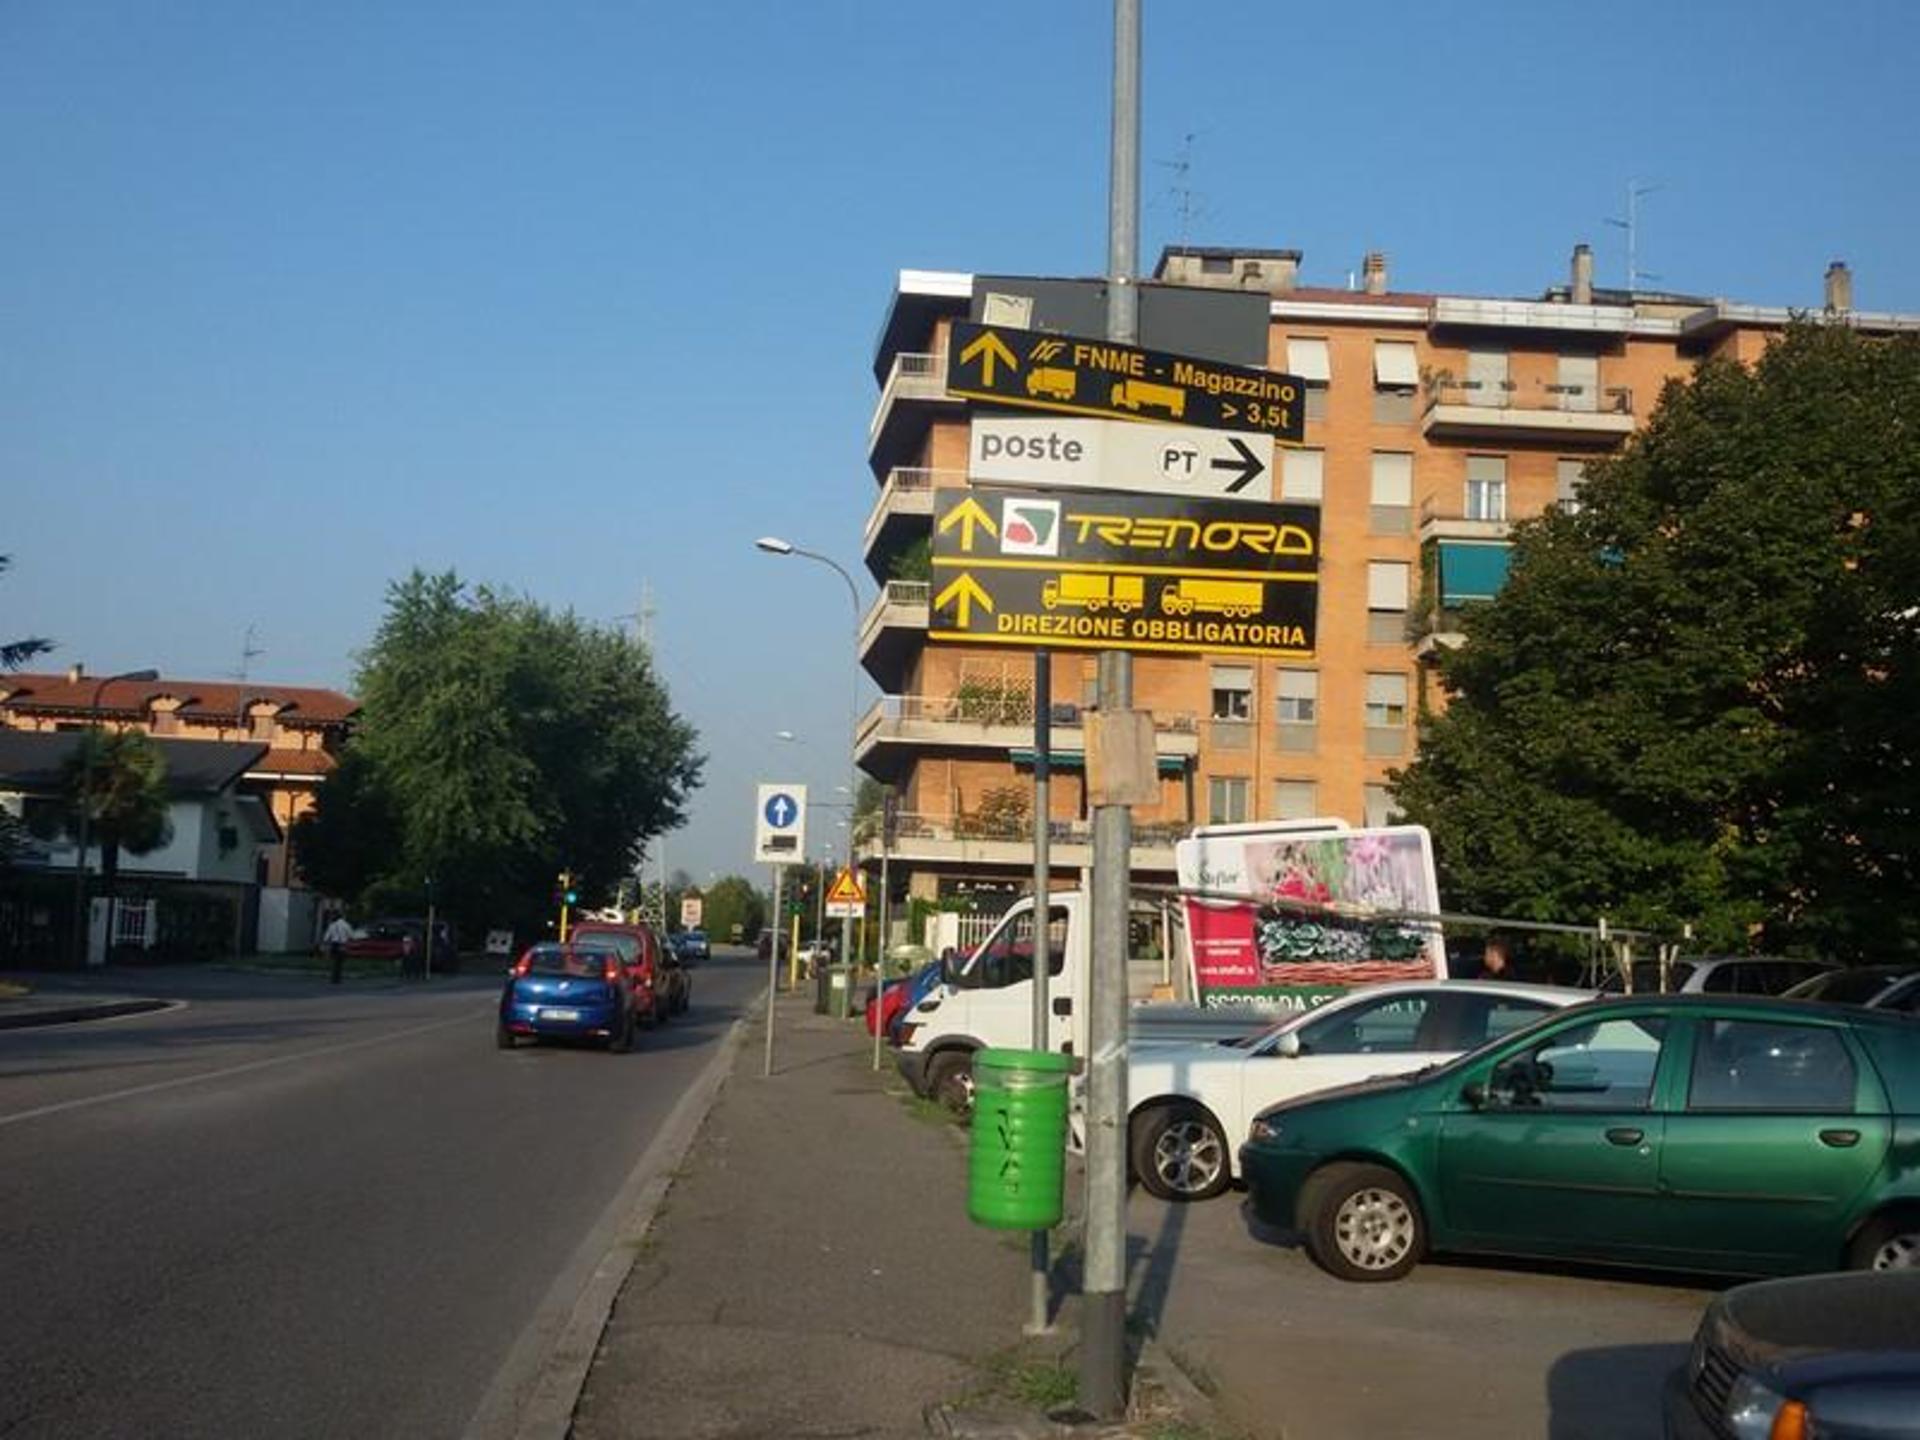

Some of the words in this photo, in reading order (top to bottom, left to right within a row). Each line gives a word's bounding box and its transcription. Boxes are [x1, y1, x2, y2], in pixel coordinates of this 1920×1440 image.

[1074, 344, 1146, 377] FNME
[1174, 361, 1296, 402] Magazzino
[1247, 402, 1289, 429] 3,5t
[981, 431, 1084, 462] poste
[1163, 448, 1198, 474] PT
[1066, 513, 1314, 556] TRENORD
[998, 613, 1125, 638] DIREZIONE
[1132, 616, 1306, 646] OBBLIGATORIA
